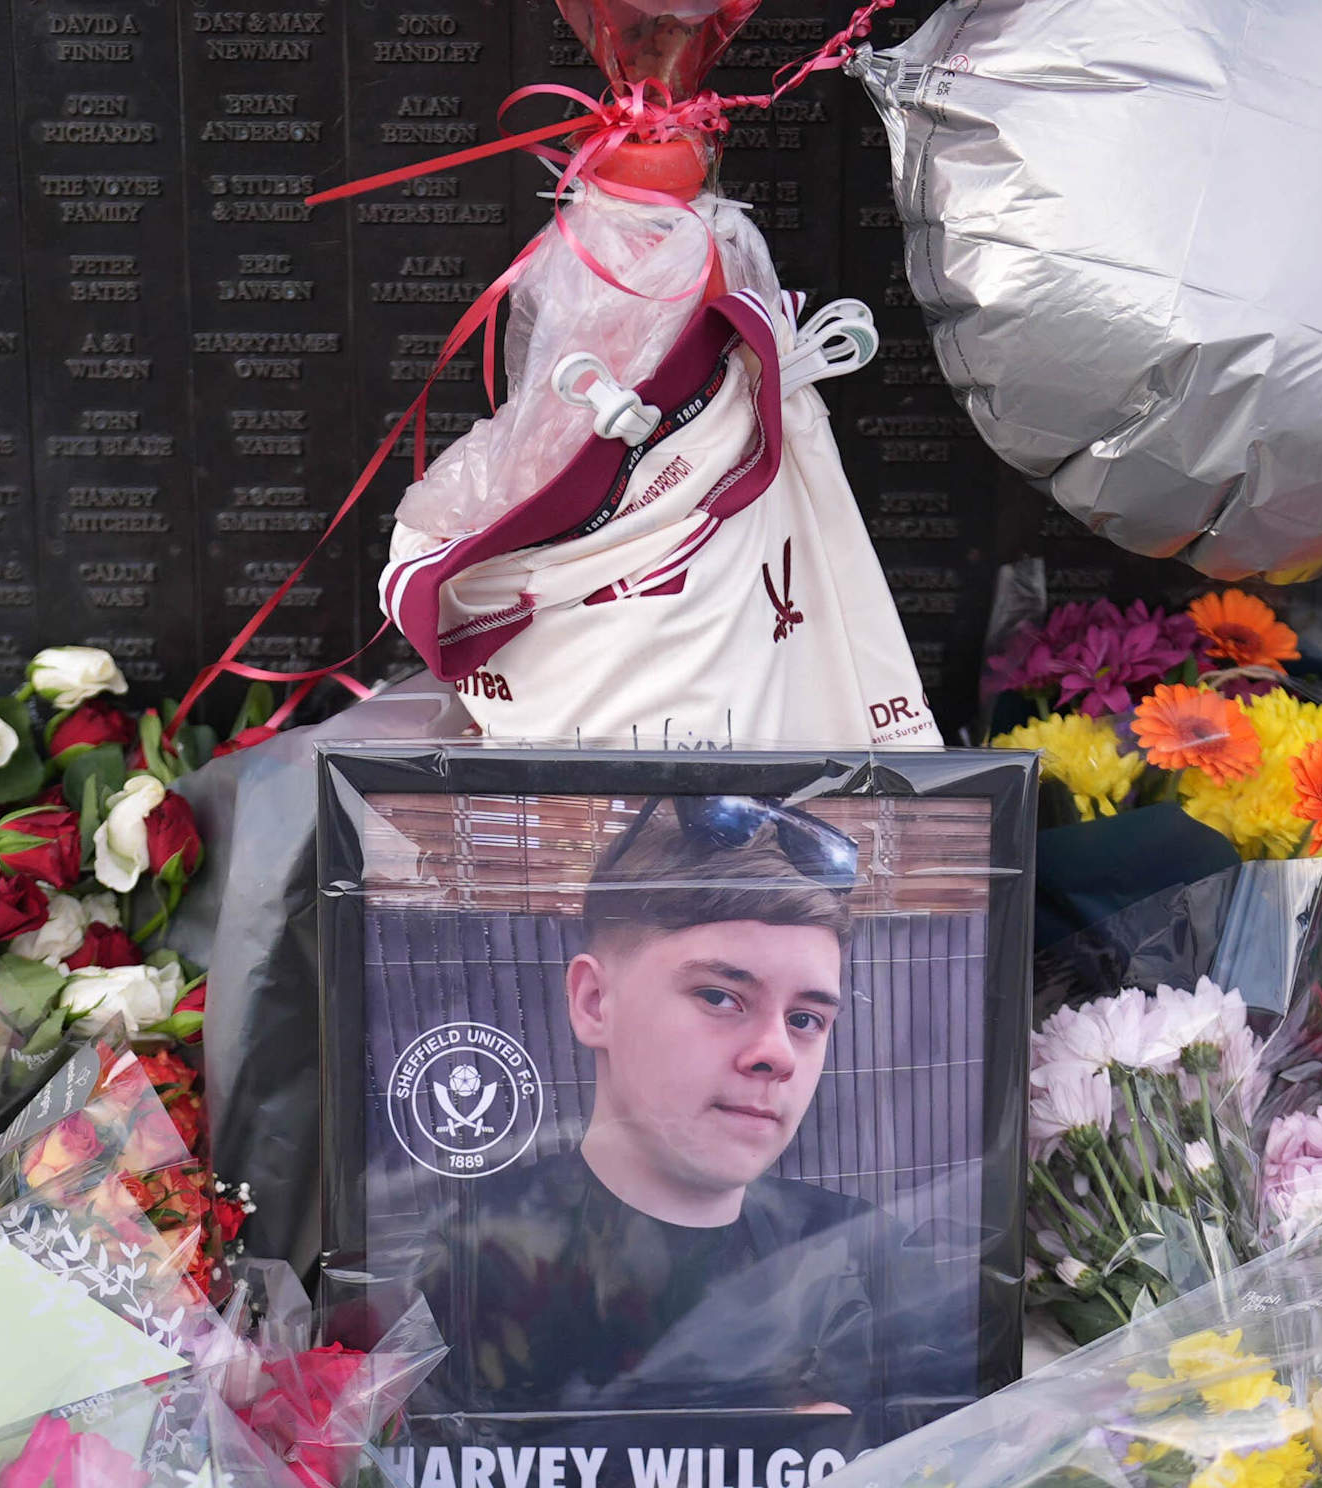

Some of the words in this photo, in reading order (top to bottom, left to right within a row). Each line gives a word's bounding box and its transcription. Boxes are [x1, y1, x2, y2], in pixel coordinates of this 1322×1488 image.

[49, 15, 122, 35] DAVID
[194, 13, 245, 33] DAN
[248, 13, 267, 33] &
[268, 13, 323, 33] MAX
[397, 15, 456, 35] JONO
[58, 42, 133, 61] FINNIE
[207, 40, 312, 61] NEWMAN
[375, 42, 483, 63] HANDLEY
[68, 96, 127, 116] JOHN
[225, 94, 298, 115] BRIAN
[398, 97, 460, 117] ALAN
[42, 123, 155, 143] RICHARDS
[201, 121, 322, 142] ANDERSON
[382, 123, 478, 144] BENISON
[40, 175, 89, 195] THE
[401, 178, 461, 198] JOHN
[62, 203, 144, 223] FAMILY
[234, 203, 316, 223] FAMILY
[357, 203, 426, 224] MYERS
[427, 203, 505, 224] BLADE
[70, 256, 139, 276] PETER
[239, 254, 292, 274] ERIC
[401, 257, 465, 277] ALAN
[72, 282, 141, 302] BATES
[218, 280, 314, 301] DAWSON
[65, 359, 152, 380] WILSON
[234, 359, 303, 379] OWEN
[869, 696, 920, 729] DR.
[894, 720, 934, 739] Surgery
[396, 1029, 462, 1100] SHEFFIELD
[466, 1028, 523, 1068] UNITED
[516, 1069, 536, 1101] F.C.
[448, 1154, 485, 1169] 1889
